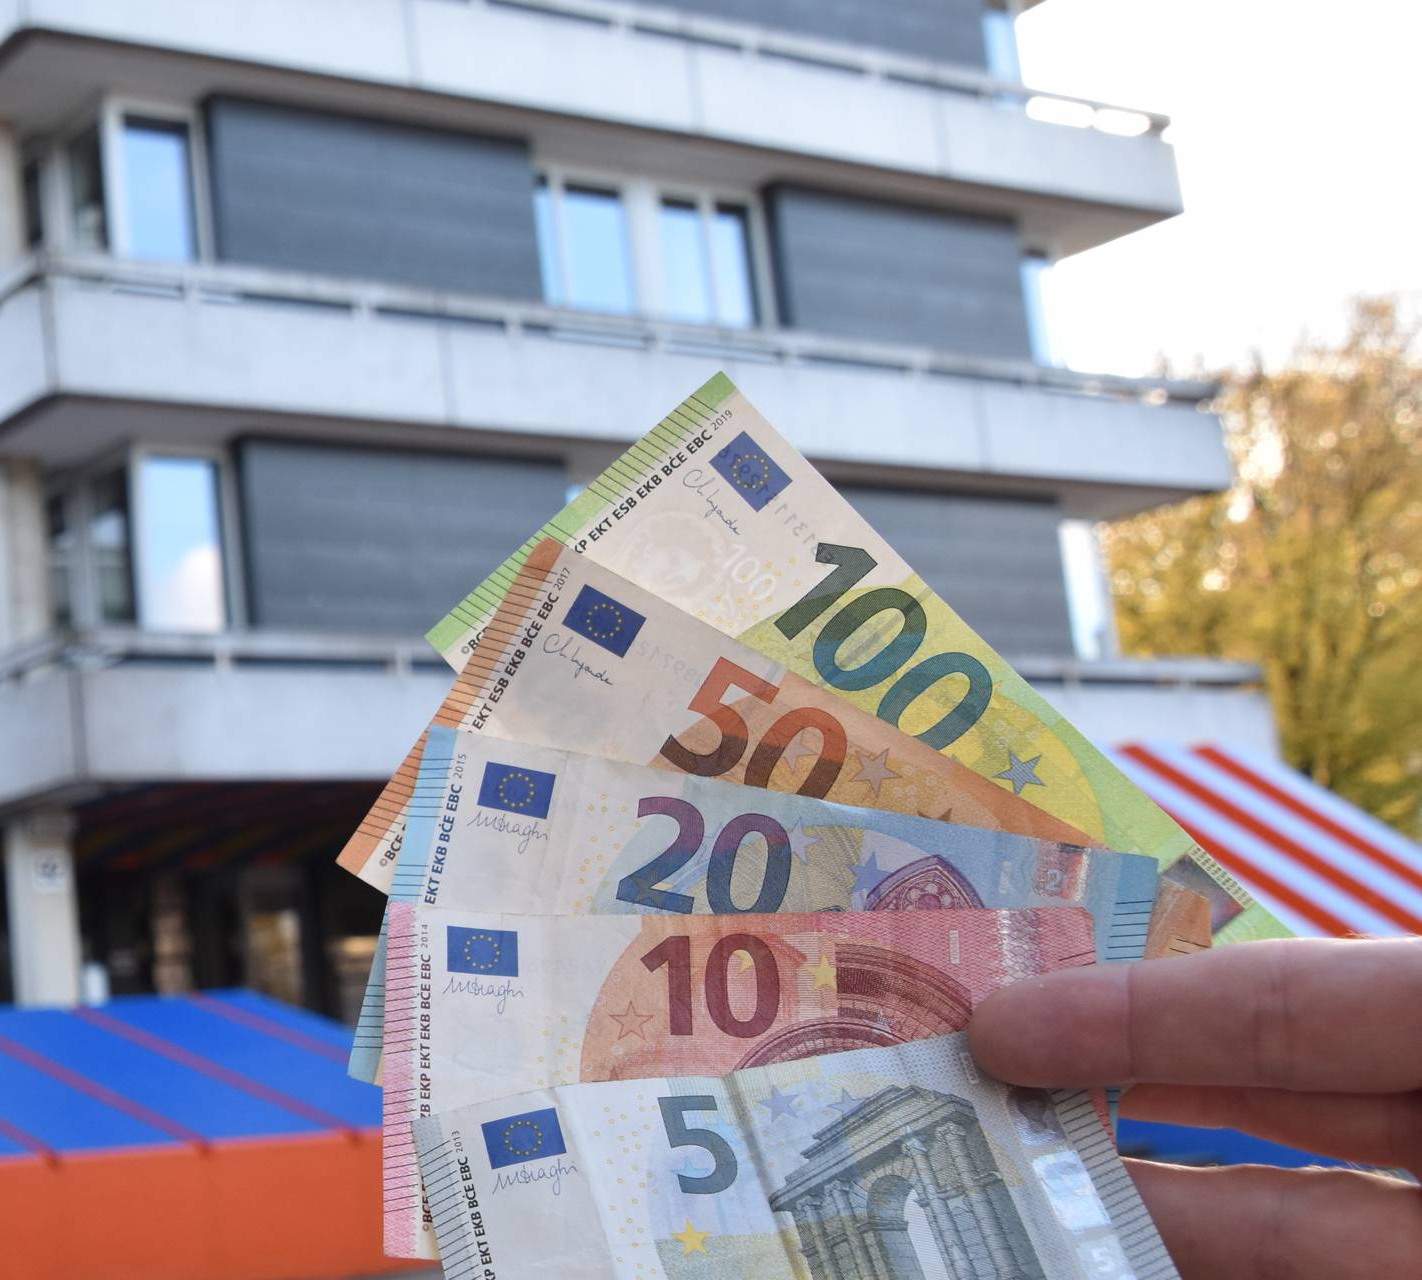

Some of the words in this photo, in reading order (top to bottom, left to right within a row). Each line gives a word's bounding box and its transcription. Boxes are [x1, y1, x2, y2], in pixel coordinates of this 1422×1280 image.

[588, 517, 613, 542] EKT
[612, 496, 637, 521] ESB
[636, 474, 662, 499] EKB
[685, 429, 713, 455] EBC
[711, 409, 733, 431] 2019
[472, 703, 493, 730] EKT
[488, 676, 509, 703] ESB
[504, 649, 526, 677] EKB
[537, 592, 559, 621] EBC
[554, 567, 571, 592] 2017
[773, 542, 993, 751] 100
[659, 655, 848, 800] 50
[453, 753, 467, 779] 2015
[446, 784, 462, 812] EBC
[431, 846, 448, 875] EKB
[615, 796, 792, 914] 20
[424, 877, 441, 905] EKT
[420, 924, 429, 949] 2014
[420, 954, 431, 980] EBC
[640, 933, 780, 1039] 10
[420, 1013, 431, 1040] EKB
[420, 1044, 431, 1069] EKT
[420, 1073, 431, 1099] EKP
[451, 1130, 464, 1153] 2013
[657, 1095, 738, 1195] 5
[457, 1156, 472, 1182] EBC
[470, 1211, 486, 1237] EKB
[477, 1240, 493, 1265] EKT
